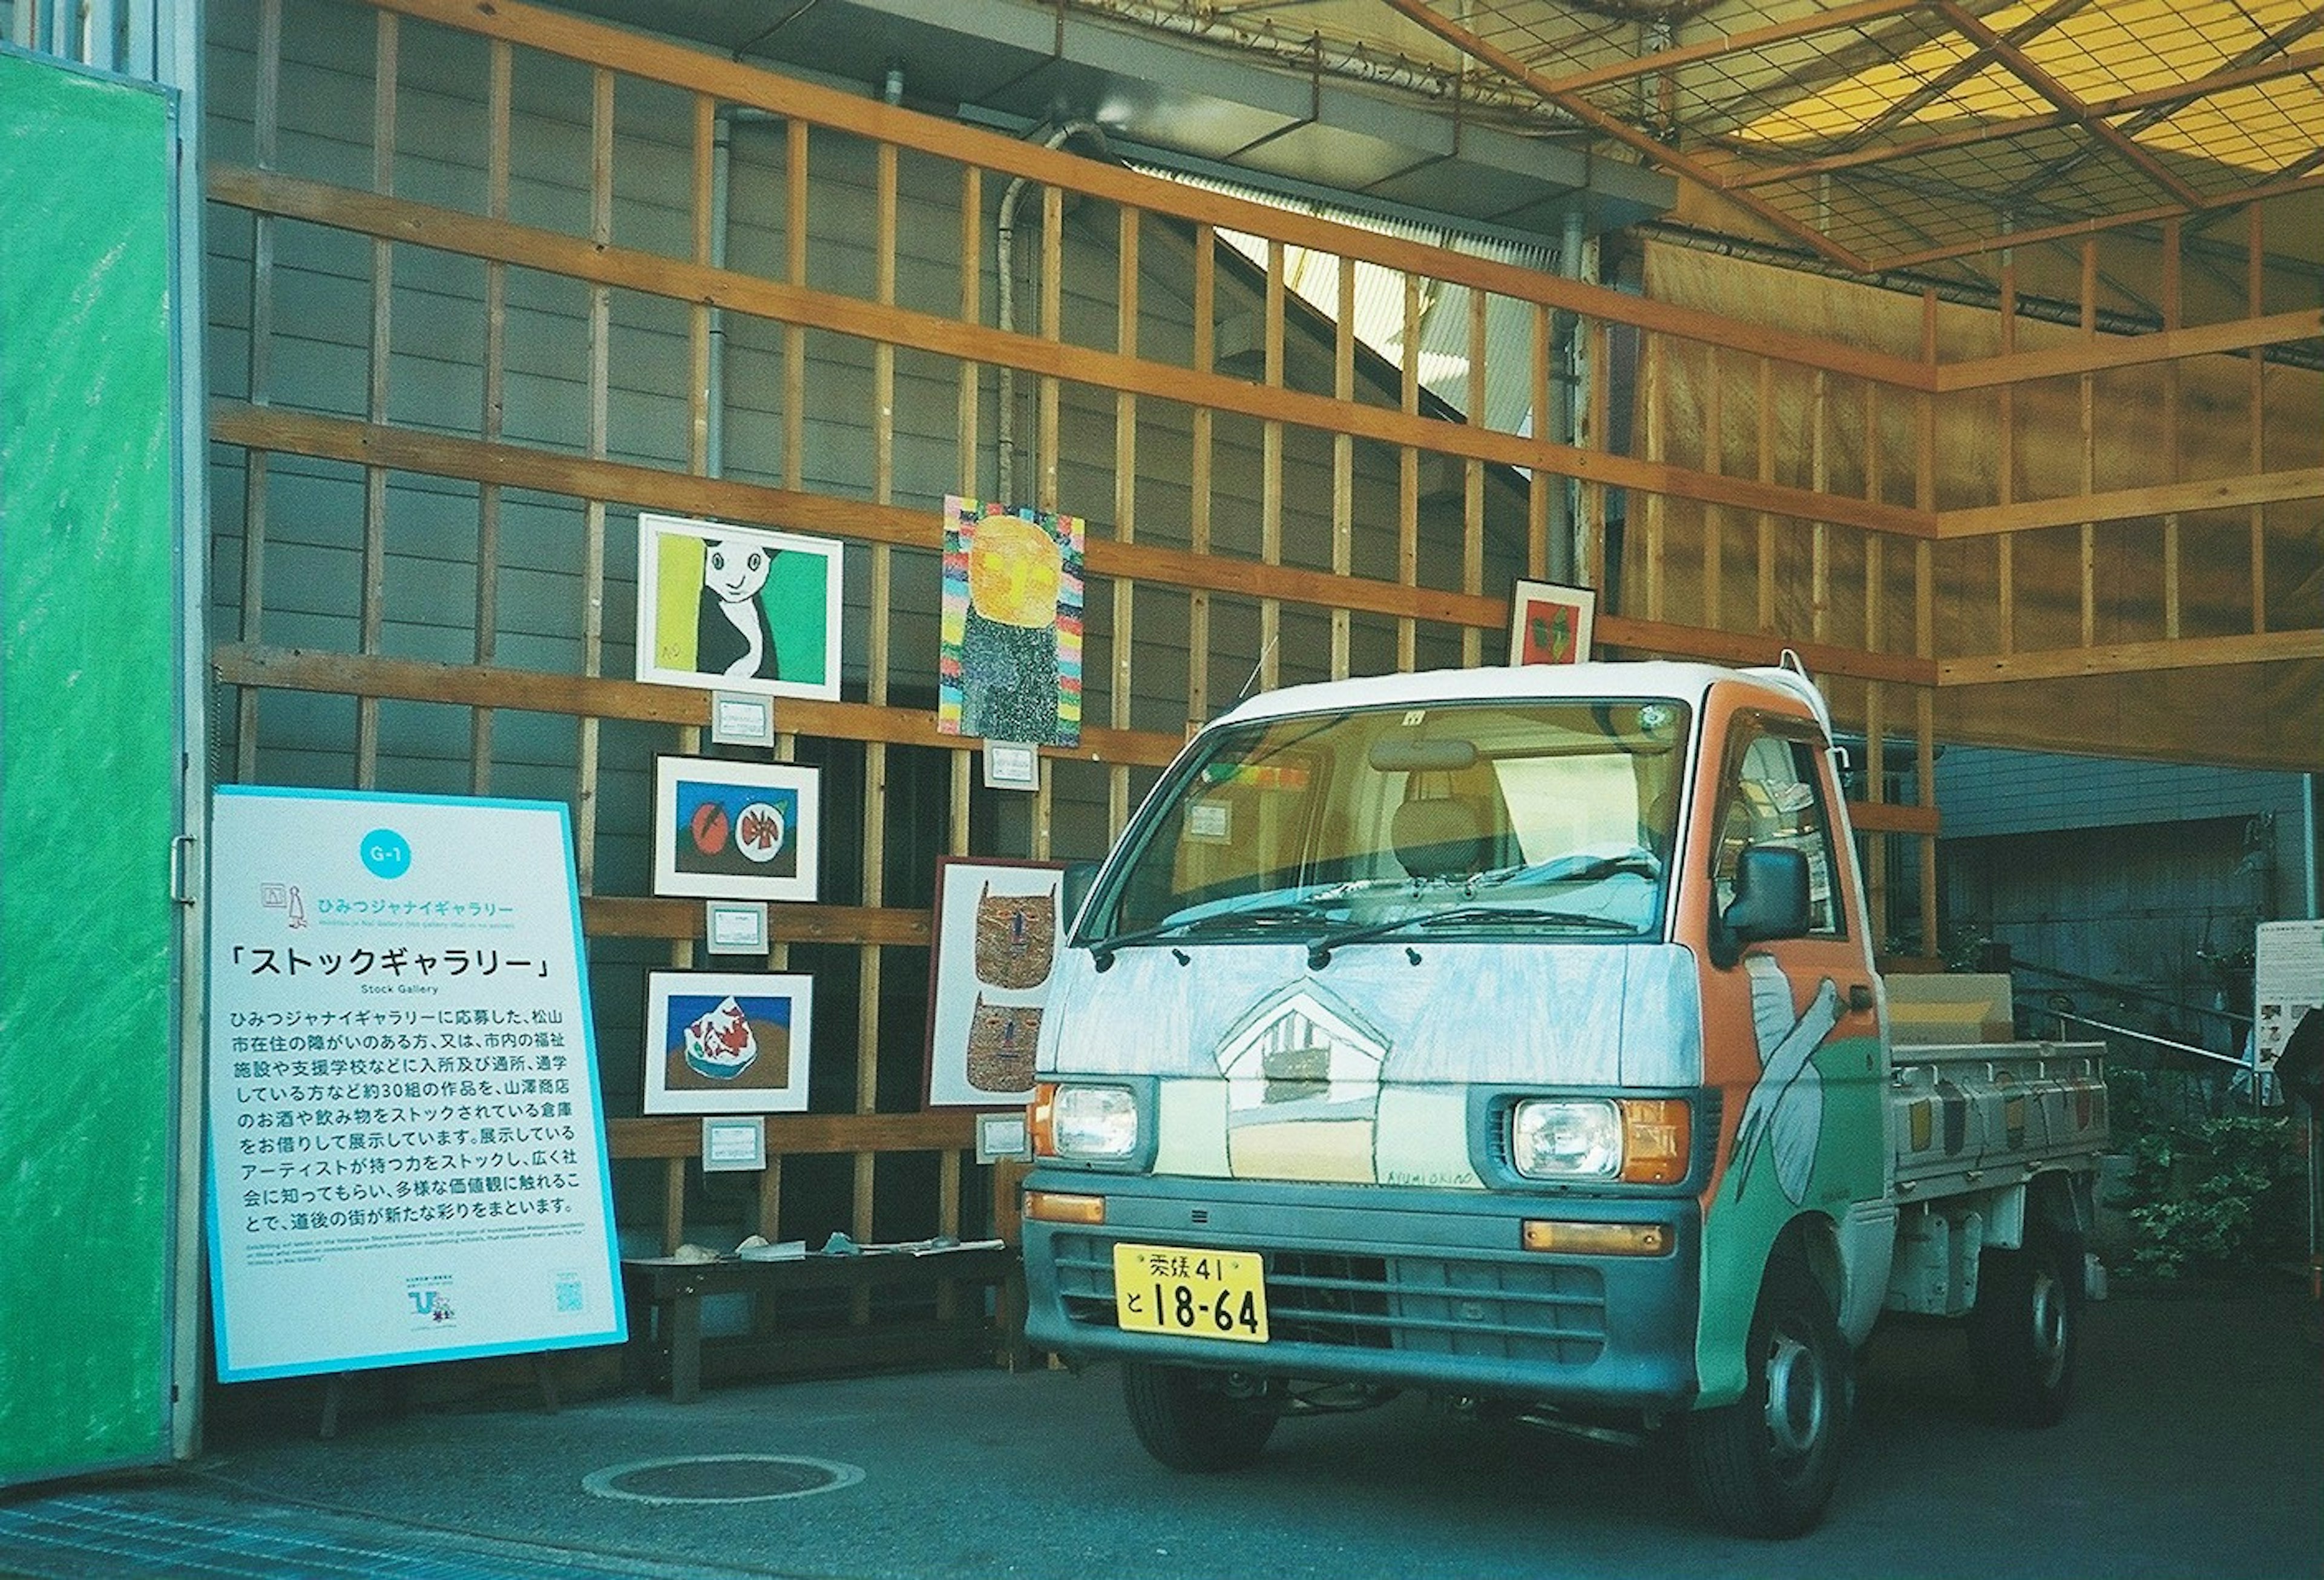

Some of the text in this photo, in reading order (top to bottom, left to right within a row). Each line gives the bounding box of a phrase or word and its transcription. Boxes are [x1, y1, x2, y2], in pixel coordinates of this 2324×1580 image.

[370, 846, 401, 861] G-1
[318, 898, 513, 916] ひみつジャナイギャラリー
[233, 946, 547, 977] 「ストックギャラリー」
[362, 985, 439, 995] Stock Gallery
[1127, 1283, 1258, 1334] と 18-64
